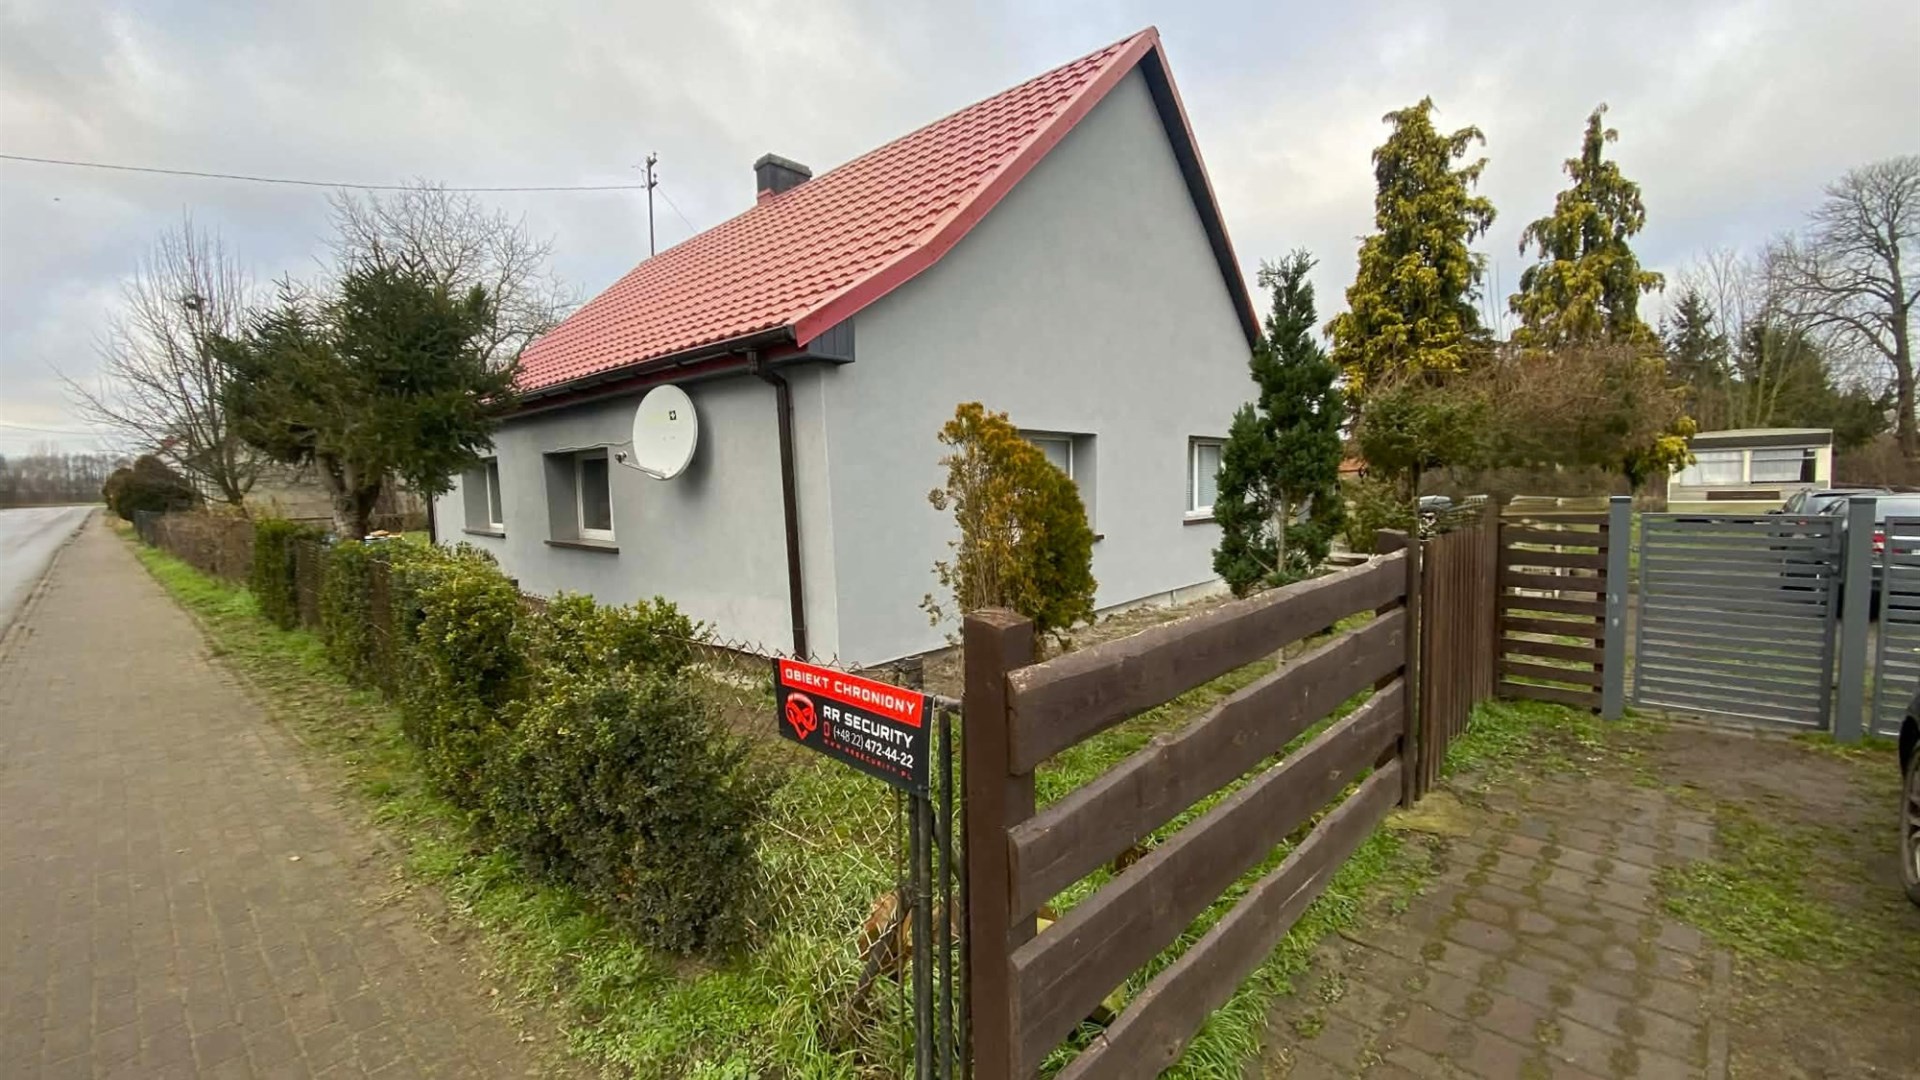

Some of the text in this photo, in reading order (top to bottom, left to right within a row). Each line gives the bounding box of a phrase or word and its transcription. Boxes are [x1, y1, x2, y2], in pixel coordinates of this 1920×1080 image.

[785, 668, 916, 715] OBIEKT CHRONIONY
[823, 704, 914, 749] RR SECURITY
[833, 725, 914, 769] (+48 22) 472-44-22
